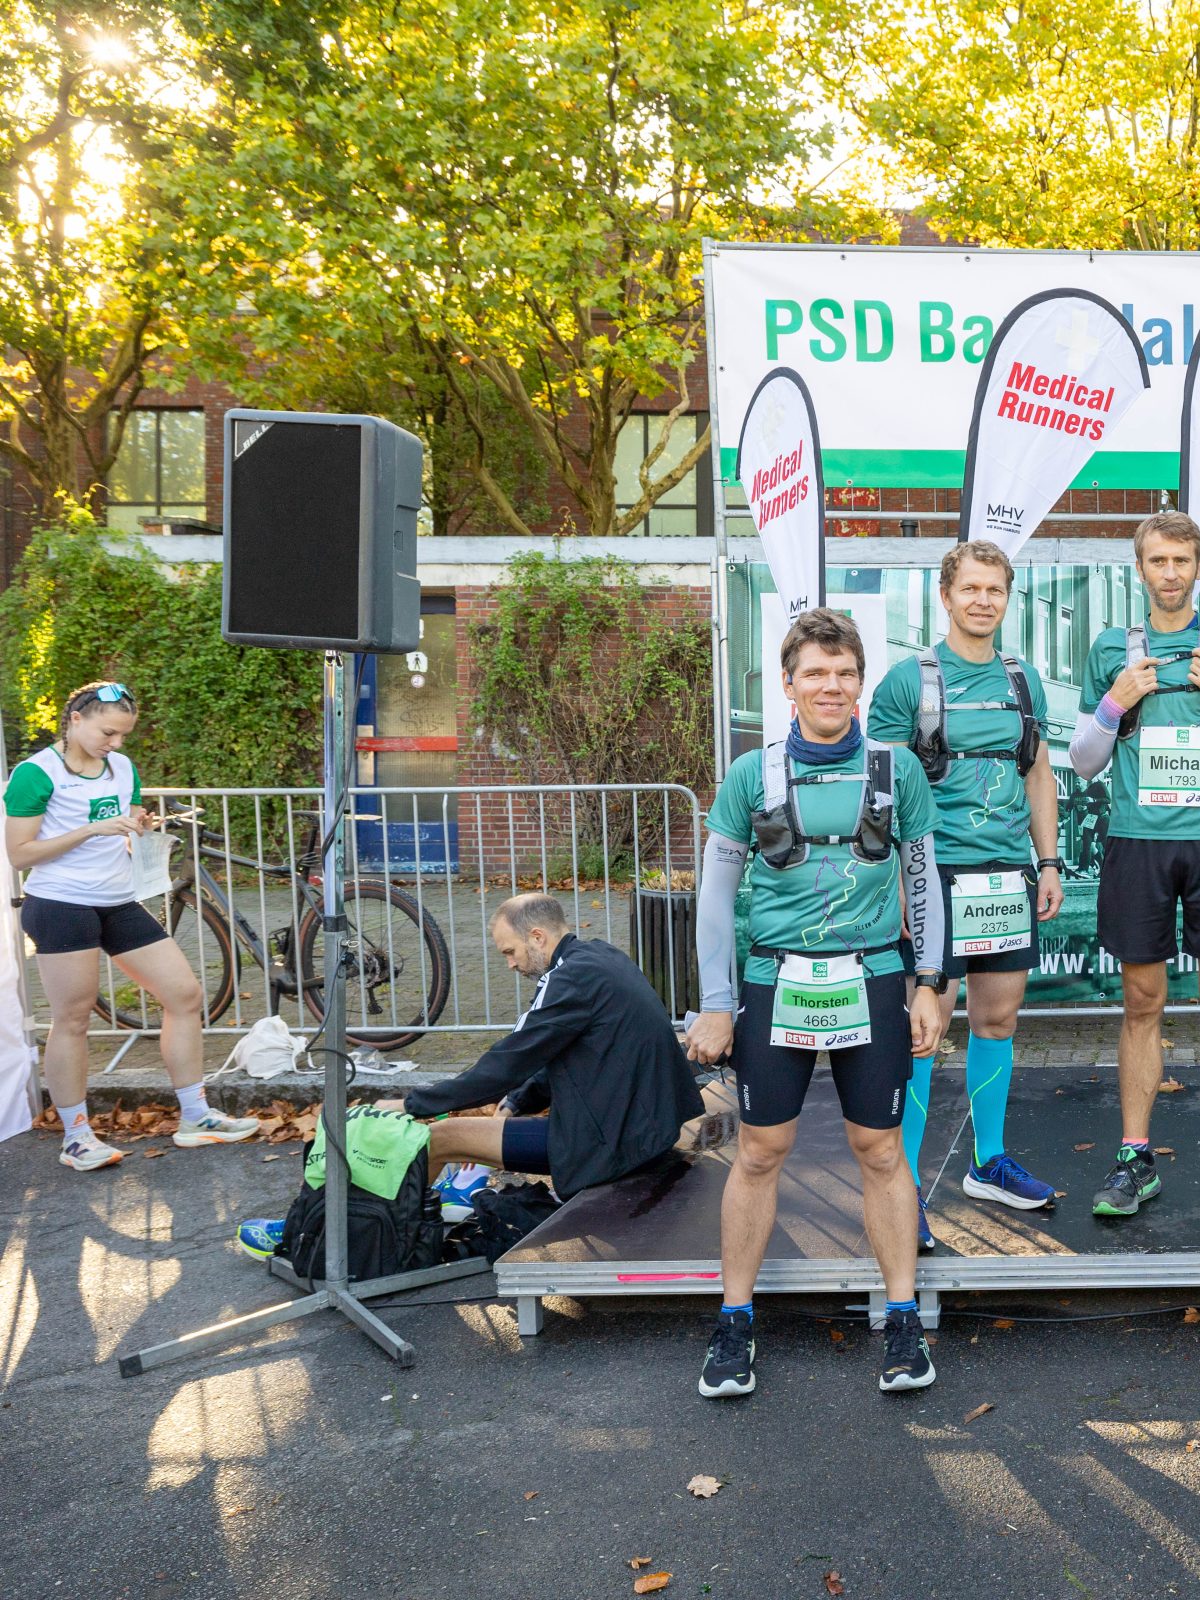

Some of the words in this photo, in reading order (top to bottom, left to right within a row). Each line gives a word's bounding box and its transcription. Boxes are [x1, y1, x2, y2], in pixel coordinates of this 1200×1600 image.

[764, 298, 894, 363] PSD
[919, 301, 994, 364] Ba
[1006, 361, 1114, 413] Medical
[997, 391, 1106, 441] Runners
[242, 424, 269, 450] BELL
[751, 439, 803, 503] Medical
[759, 475, 809, 530] Runners
[987, 503, 1024, 520] MHV
[789, 596, 808, 613] MH
[1168, 775, 1197, 786] 1793
[1151, 793, 1177, 802] REWE
[907, 836, 927, 876] Coas
[912, 877, 927, 897] to
[963, 903, 1024, 918] Andreas
[981, 921, 1009, 933] 2375
[965, 942, 991, 951] REWE
[1007, 937, 1023, 947] asics
[792, 995, 849, 1009] Thorsten
[803, 1014, 838, 1027] 4663
[787, 1033, 814, 1045] REWE
[836, 1032, 859, 1043] asics
[743, 1084, 751, 1111] FUSION
[891, 1088, 900, 1115] FUSION
